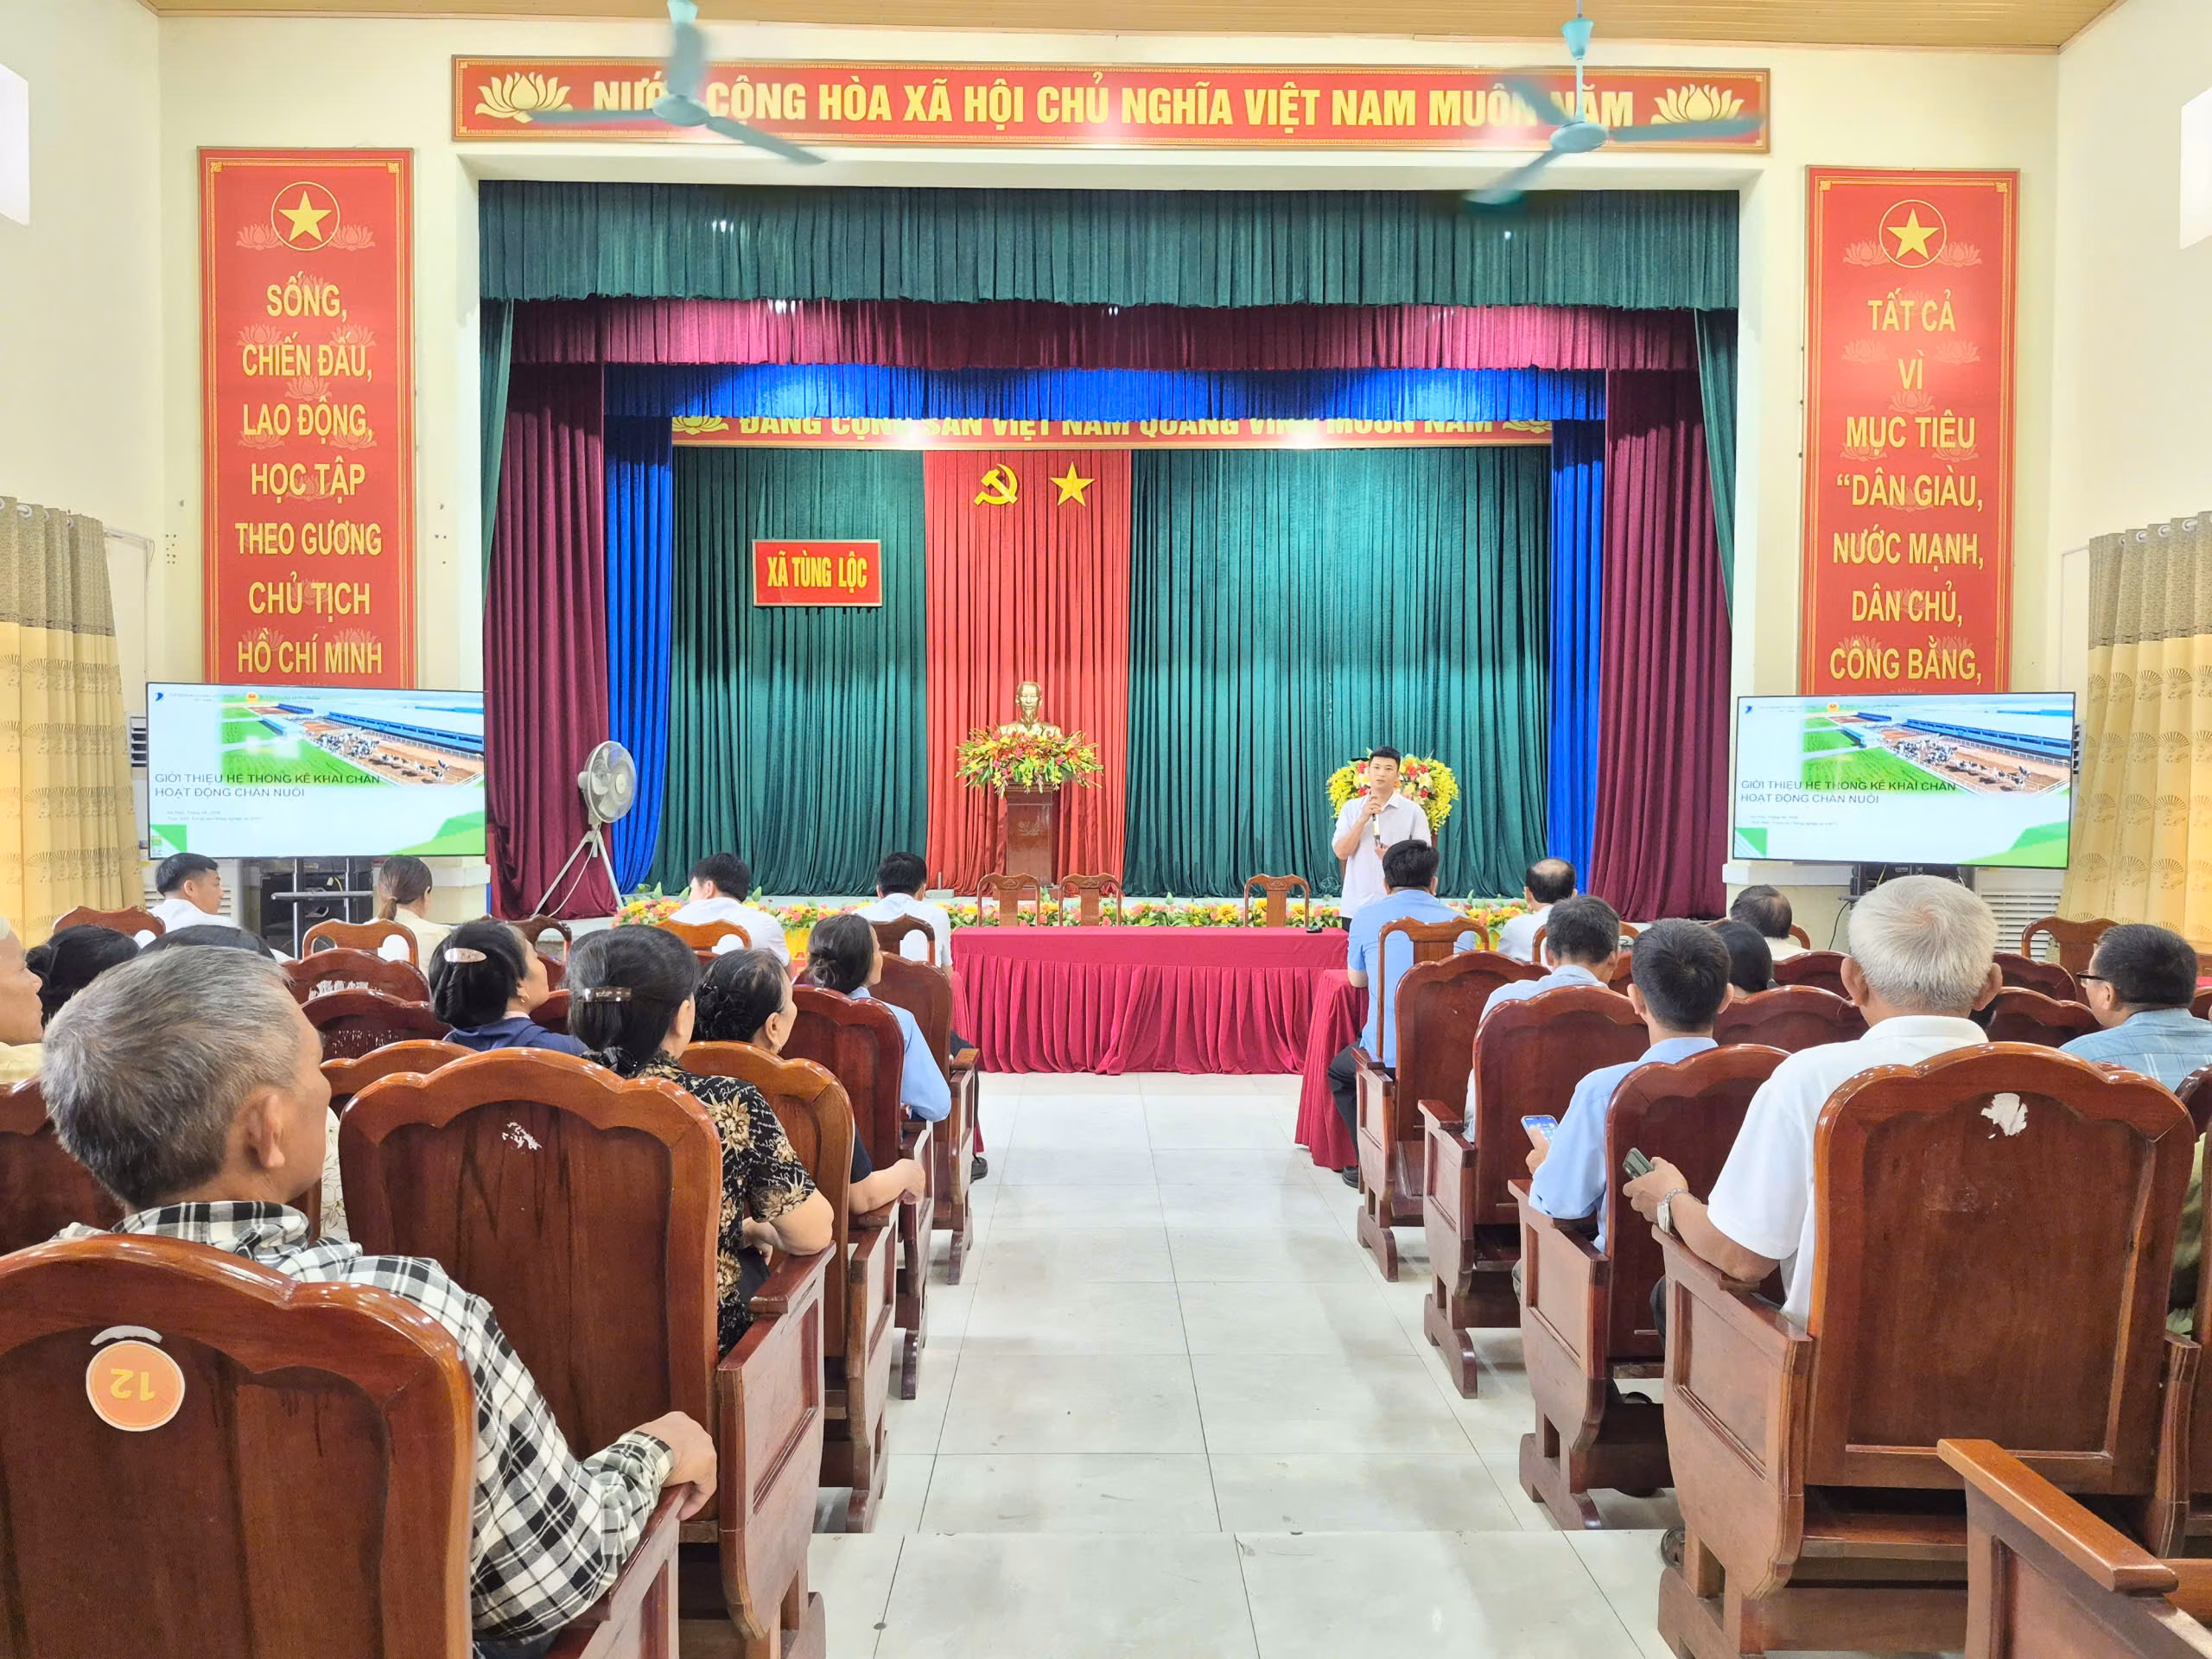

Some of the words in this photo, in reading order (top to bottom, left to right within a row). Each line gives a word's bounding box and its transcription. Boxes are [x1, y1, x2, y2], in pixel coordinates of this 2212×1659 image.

[594, 71, 671, 111] NƯỚ
[706, 74, 806, 126] CỘNG
[818, 75, 893, 121] HÒA
[903, 78, 953, 122] XÃ
[964, 78, 1024, 130] HỘI
[1036, 71, 1109, 124] CHỦ
[1121, 81, 1234, 125] NGHĨA
[1243, 81, 1321, 134] VIỆT
[1332, 89, 1416, 126] NAM
[1428, 83, 1538, 126] MUÔN
[266, 271, 347, 322] SỐNG,
[1867, 288, 1915, 331] TẤT
[1921, 289, 1956, 332] CẢ
[242, 332, 311, 377] CHIẾN
[317, 332, 372, 382] ĐẤU,
[1897, 349, 1924, 390] VÌ
[243, 404, 291, 436] LAO
[297, 395, 372, 444] ĐỘNG,
[1847, 416, 1907, 456] MỤC
[1915, 409, 1975, 448] TIÊU
[251, 462, 307, 504] HỌC
[314, 455, 365, 504] TẬP
[1914, 465, 1983, 512] GIÀU,
[235, 523, 295, 555] THEO
[302, 519, 382, 556] GƯƠNG
[1833, 524, 1901, 564] NƯỚC
[1909, 532, 1984, 572] MẠNH,
[767, 550, 789, 587] XÃ
[791, 550, 832, 588] TÙNG
[838, 550, 868, 594] LỘC
[249, 571, 302, 614] CHỦ
[311, 582, 370, 622] TỊCH
[1852, 582, 1901, 622] DÂN
[1908, 581, 1963, 627] CHỦ,
[238, 627, 271, 673] HỒ
[278, 633, 318, 673] CHÍ
[325, 641, 382, 674] MINH
[1830, 639, 1900, 679] CÔNG
[1907, 635, 1982, 685] BẰNG,
[110, 1368, 156, 1402] 12
